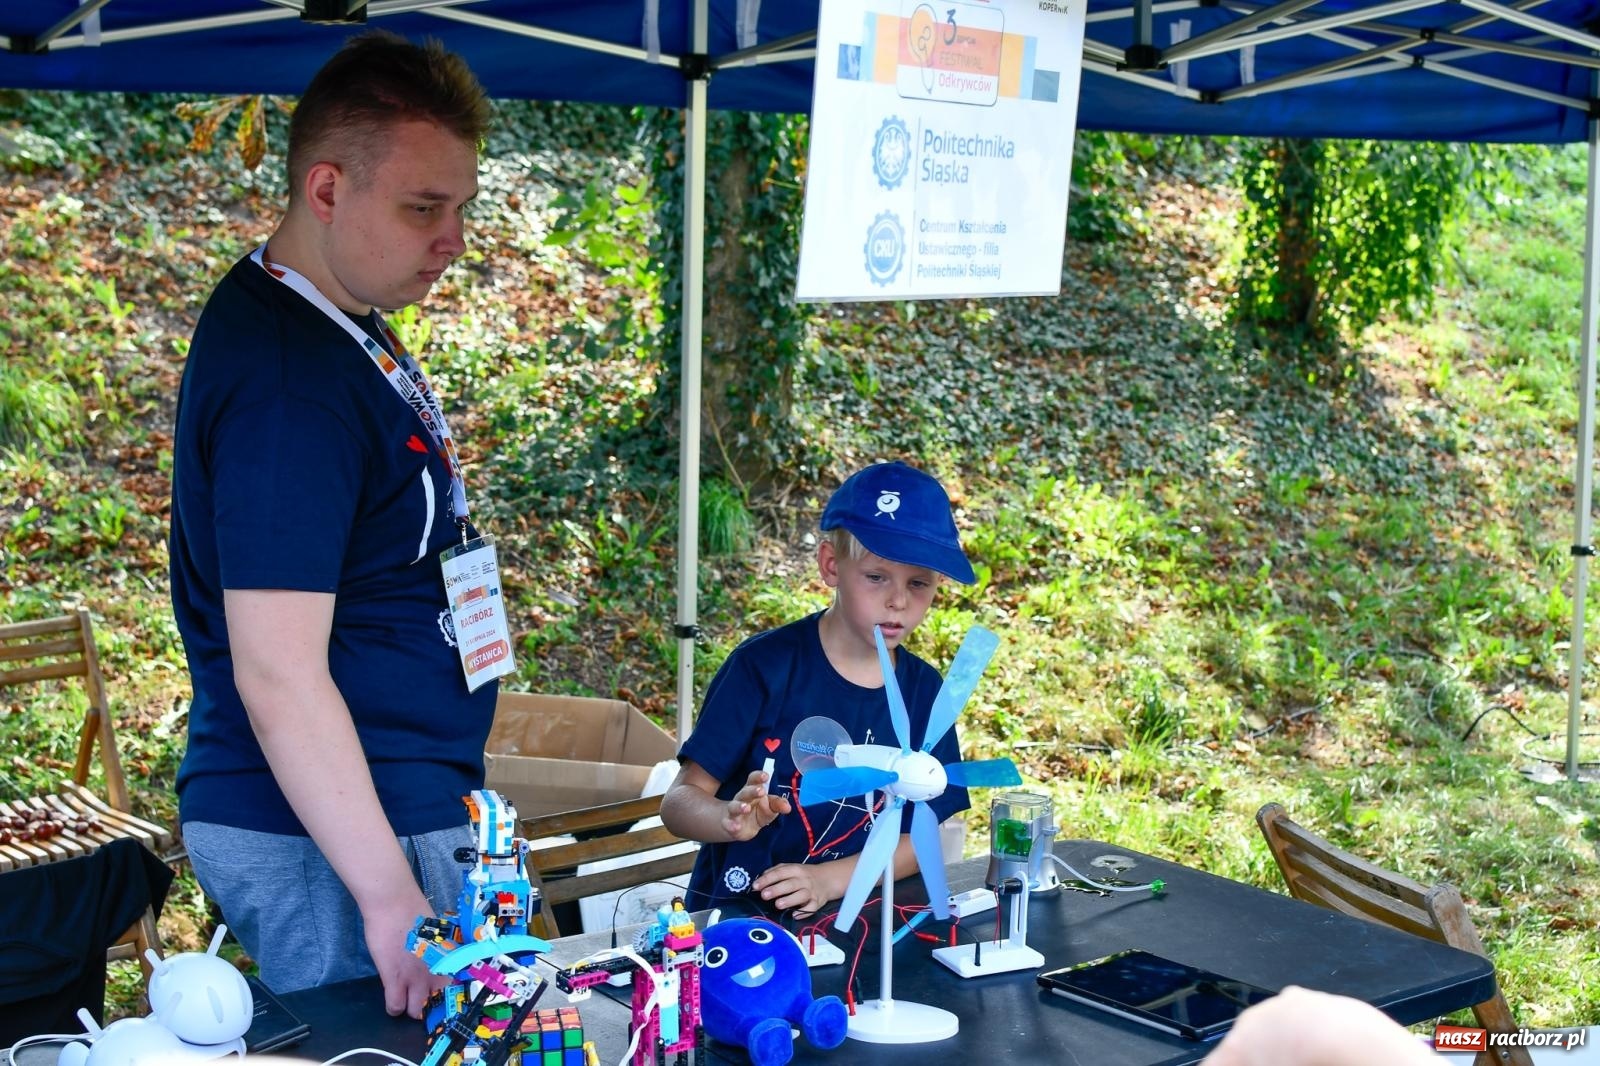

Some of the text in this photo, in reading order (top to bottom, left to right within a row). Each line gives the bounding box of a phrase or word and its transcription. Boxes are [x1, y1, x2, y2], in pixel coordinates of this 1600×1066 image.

[943, 9, 957, 46] 3
[938, 72, 992, 93] Odkrywców
[923, 129, 1015, 160] Politechnika
[921, 154, 970, 186] Śląska
[919, 218, 1007, 235] Centrum Kształcenia
[918, 240, 977, 259] Ustawicznego
[983, 241, 1000, 256] filia
[917, 259, 1002, 281] Politechniki Śląskiej
[460, 607, 494, 629] RACIBÓRZ
[467, 646, 503, 670] WYSTAWCA
